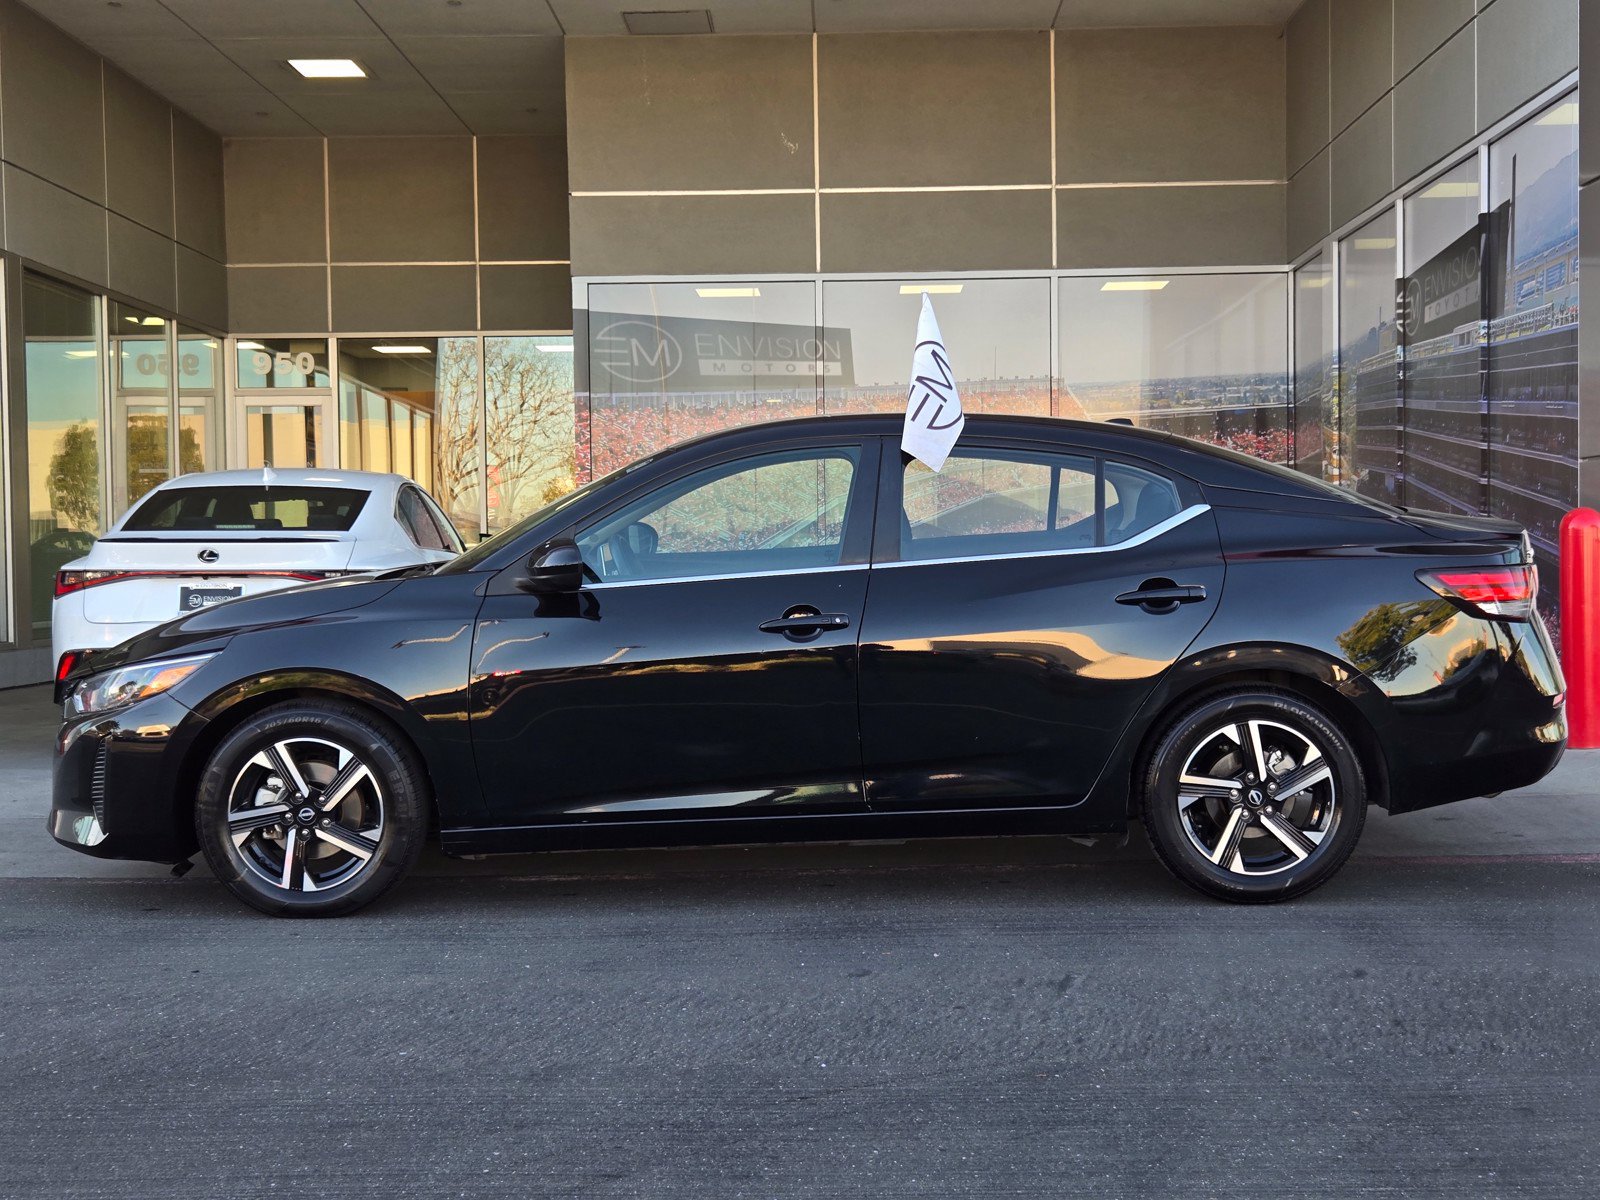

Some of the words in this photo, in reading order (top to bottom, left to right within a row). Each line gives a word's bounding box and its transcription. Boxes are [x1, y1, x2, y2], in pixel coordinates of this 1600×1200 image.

[1428, 284, 1479, 318] TOYOT
[694, 332, 841, 361] ENVISION
[252, 352, 315, 375] 950
[712, 361, 832, 374] MOTORS
